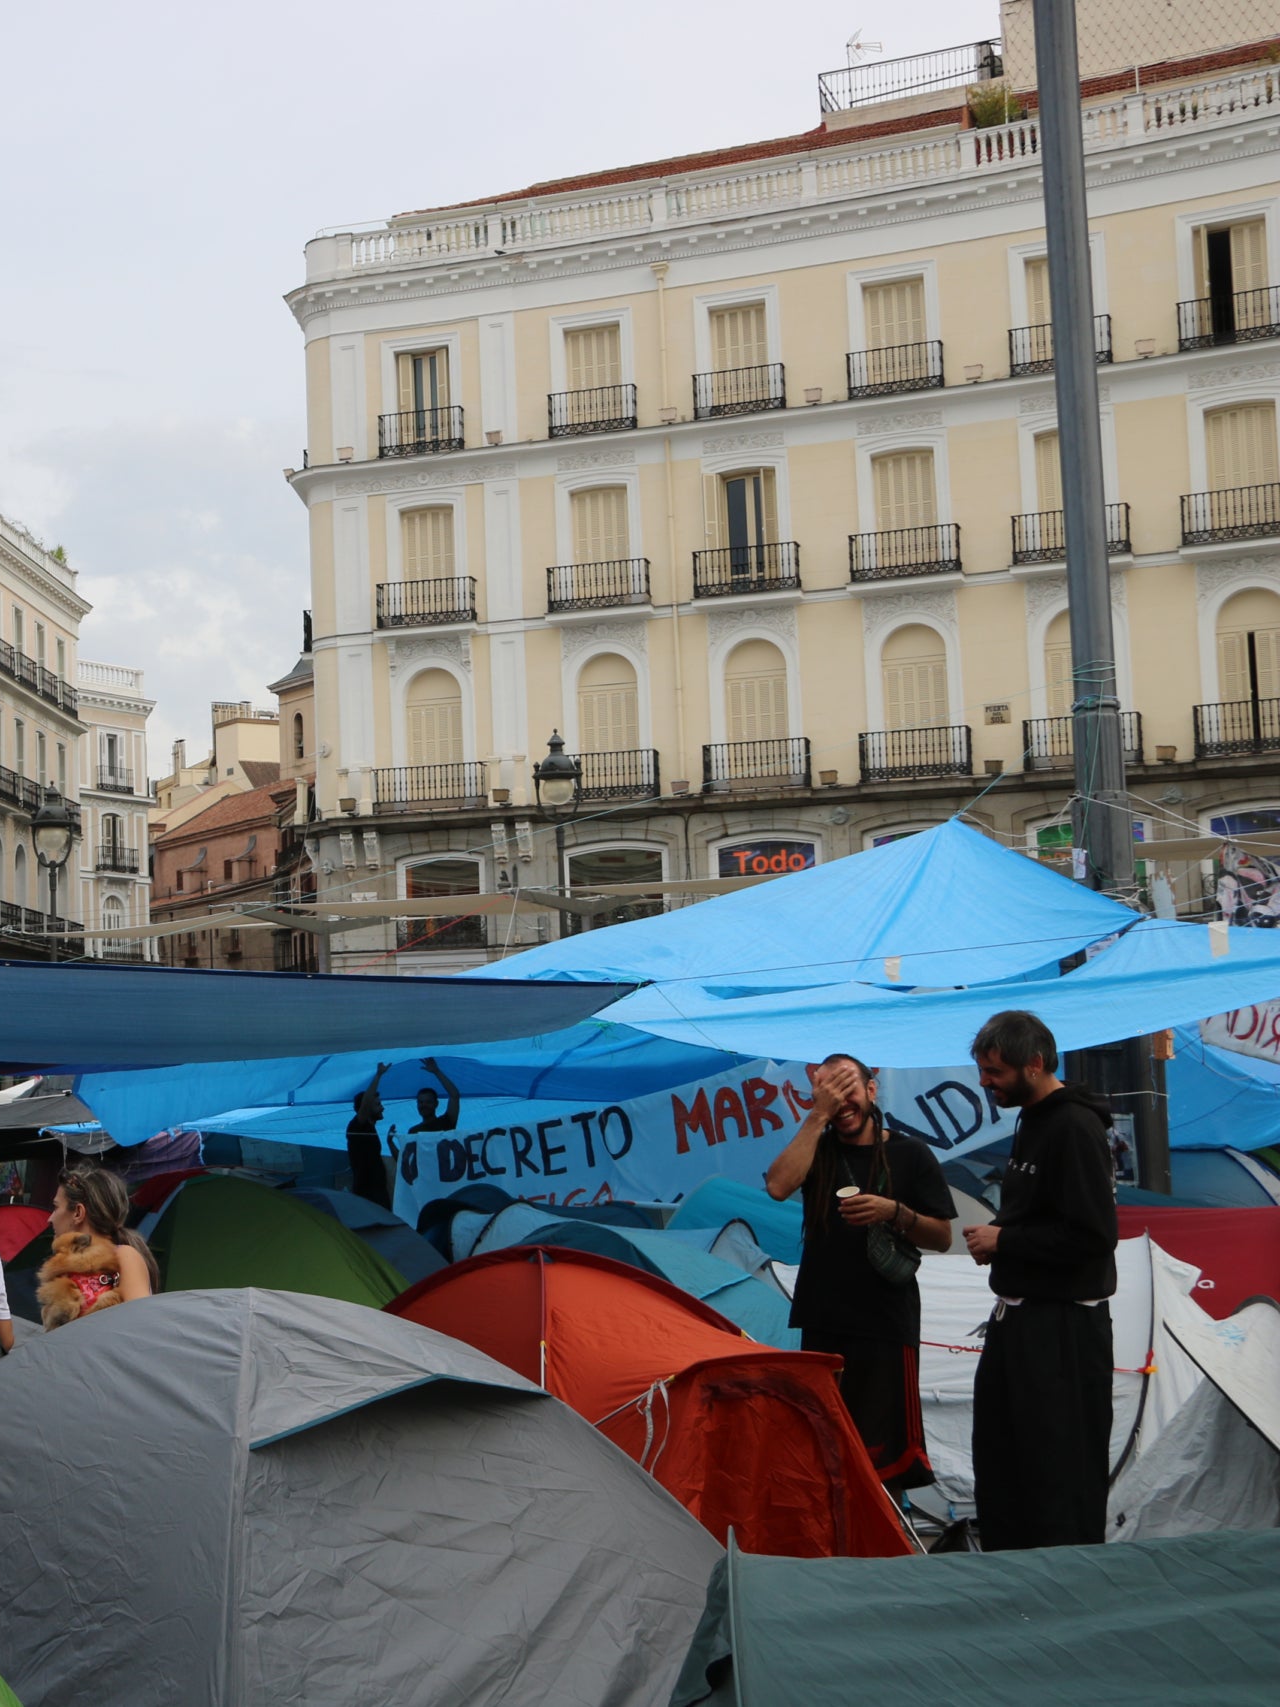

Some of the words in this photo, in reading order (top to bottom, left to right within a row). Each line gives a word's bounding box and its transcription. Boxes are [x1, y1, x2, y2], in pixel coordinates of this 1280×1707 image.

[984, 704, 1009, 713] PUERTA
[990, 715, 1005, 724] SOL
[732, 849, 808, 875] Todo
[436, 1105, 633, 1183] DECRETO
